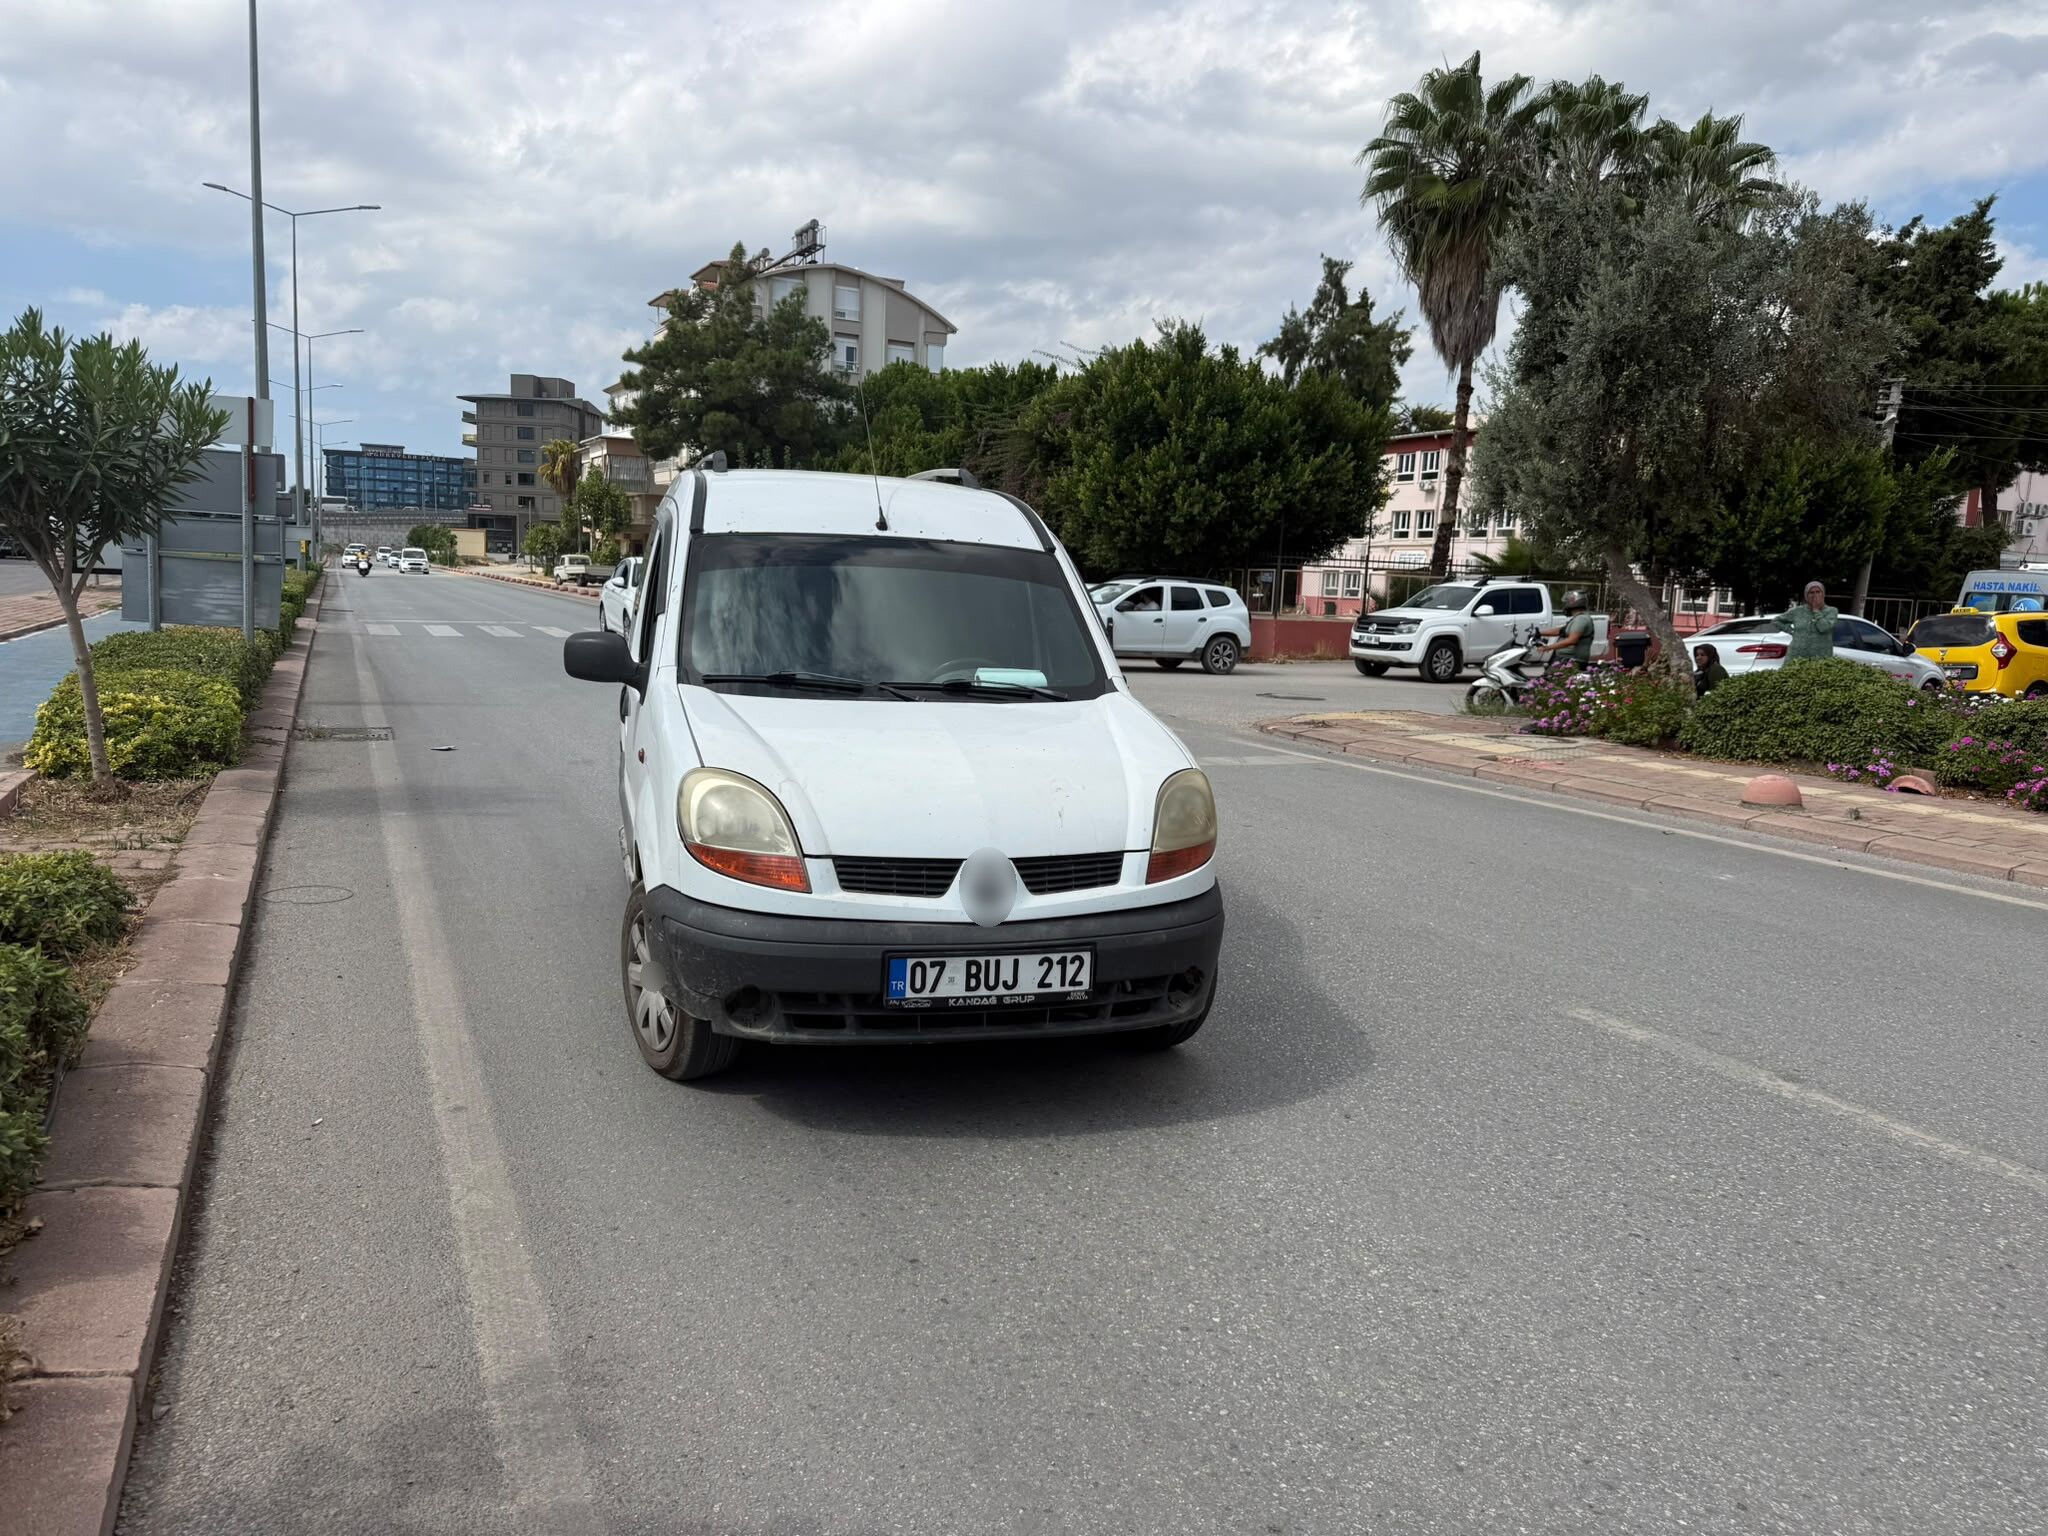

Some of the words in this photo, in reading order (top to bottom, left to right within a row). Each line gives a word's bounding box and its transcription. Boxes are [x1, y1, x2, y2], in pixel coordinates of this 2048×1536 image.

[1973, 582, 2005, 591] HASTA
[891, 981, 905, 991] TR
[909, 960, 947, 994] 07
[964, 958, 1020, 992] BUJ
[1037, 954, 1085, 989] 212
[1002, 995, 1035, 1005] GRUP
